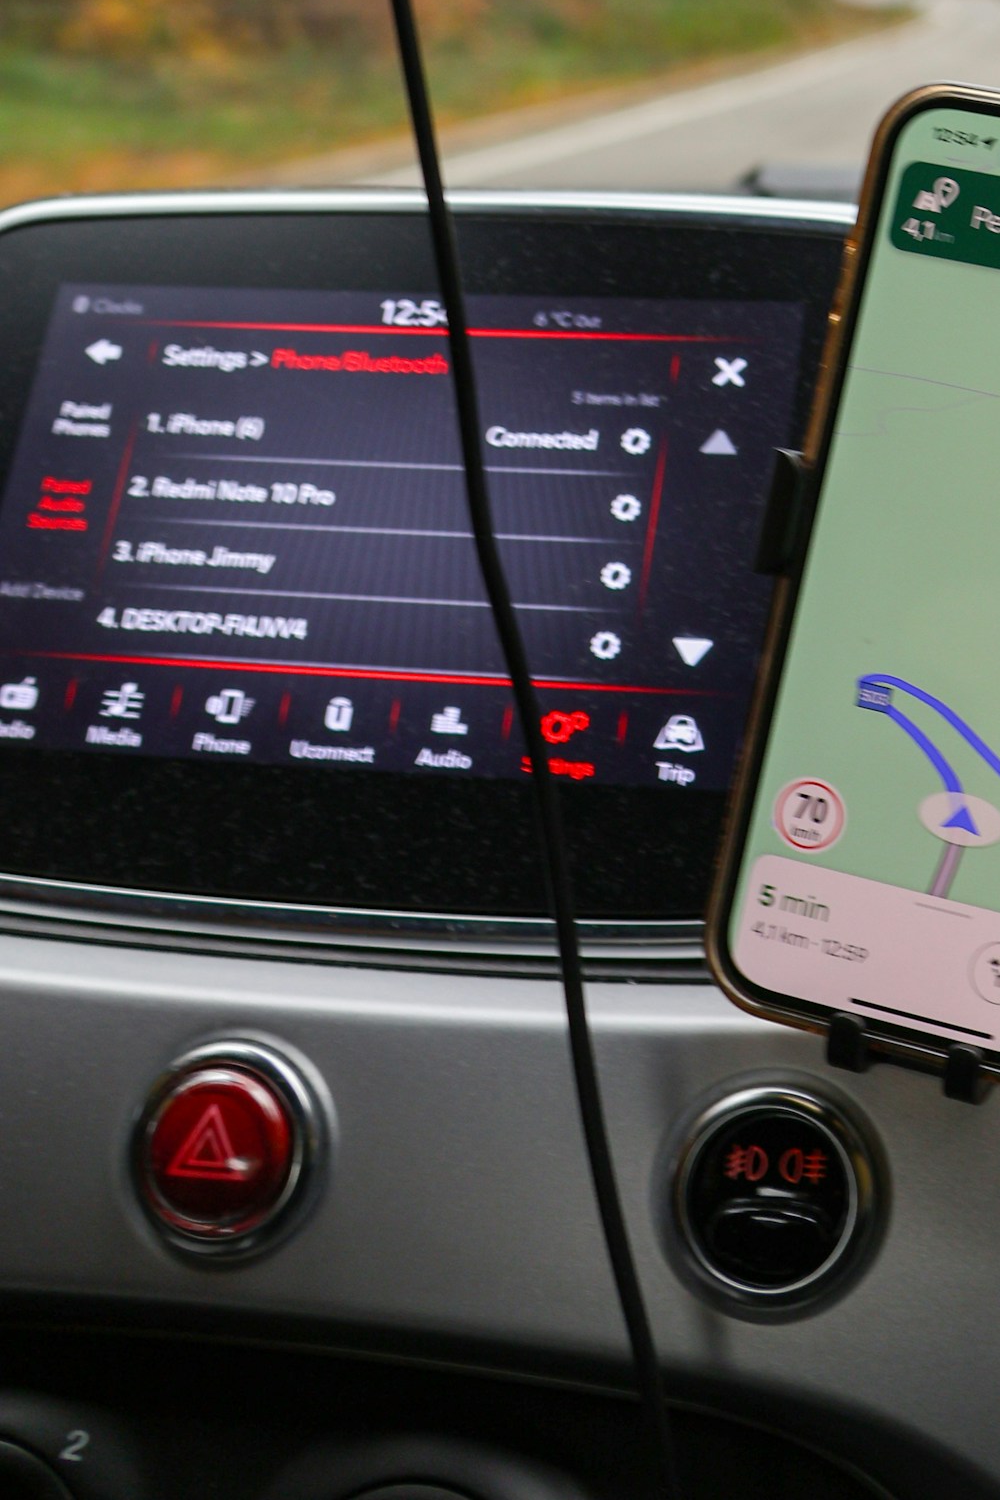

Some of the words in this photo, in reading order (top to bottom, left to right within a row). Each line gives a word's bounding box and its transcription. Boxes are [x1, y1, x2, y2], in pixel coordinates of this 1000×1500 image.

[932, 125, 979, 148] 12:54
[163, 343, 248, 373] Settings
[167, 413, 235, 437] iPhone
[486, 425, 599, 451] Connected
[151, 476, 218, 501] Redmi
[218, 480, 268, 503] Note
[271, 482, 299, 504] 10
[299, 483, 336, 507] Pro
[135, 541, 206, 566] iPhone
[206, 545, 277, 574] Jimmy
[85, 725, 143, 748] Media
[191, 731, 252, 756] Phone
[289, 739, 375, 764] Uconnect
[414, 746, 473, 771] Audio
[655, 761, 696, 787] Trip
[793, 792, 829, 825] 70
[757, 884, 776, 907] 5
[779, 894, 832, 924] min
[779, 927, 811, 950] km
[59, 1430, 90, 1462] 2
